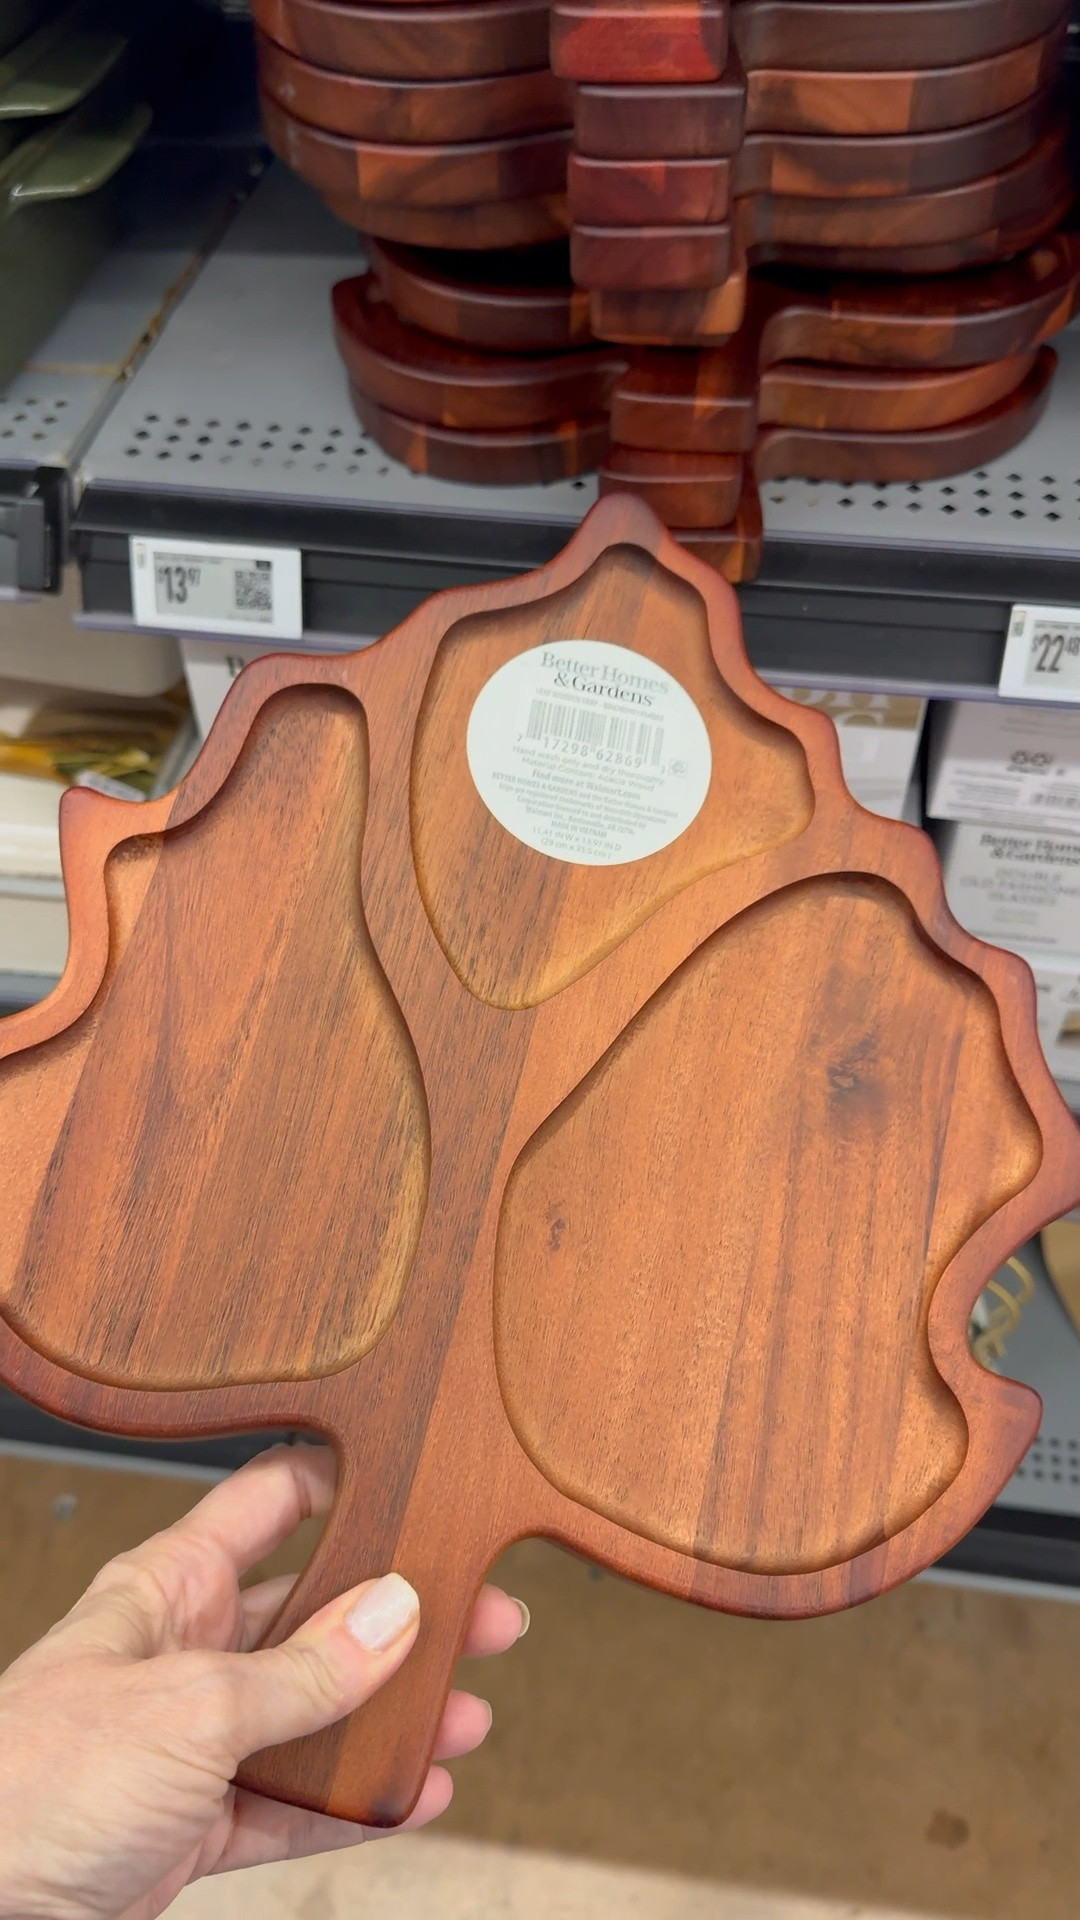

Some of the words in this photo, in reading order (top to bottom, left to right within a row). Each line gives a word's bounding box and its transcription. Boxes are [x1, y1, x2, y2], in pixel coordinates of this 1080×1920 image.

[540, 652, 599, 677] Better
[600, 666, 669, 693] Homes
[512, 745, 535, 755] Hand
[537, 751, 559, 760] wash
[561, 756, 579, 766] only
[582, 761, 599, 770] and
[600, 765, 614, 774] dry
[617, 770, 664, 785] thoroughly
[543, 736, 589, 756] 17298
[596, 748, 641, 769] 62869
[492, 771, 516, 782] BETTER
[517, 777, 540, 787] HOMES
[521, 757, 556, 769] Material
[627, 780, 654, 791] Wood
[532, 769, 550, 780] Find
[551, 775, 573, 785] more
[585, 782, 640, 800] Walmart.com
[551, 820, 568, 829] MADE
[578, 826, 607, 838] VIETNAM
